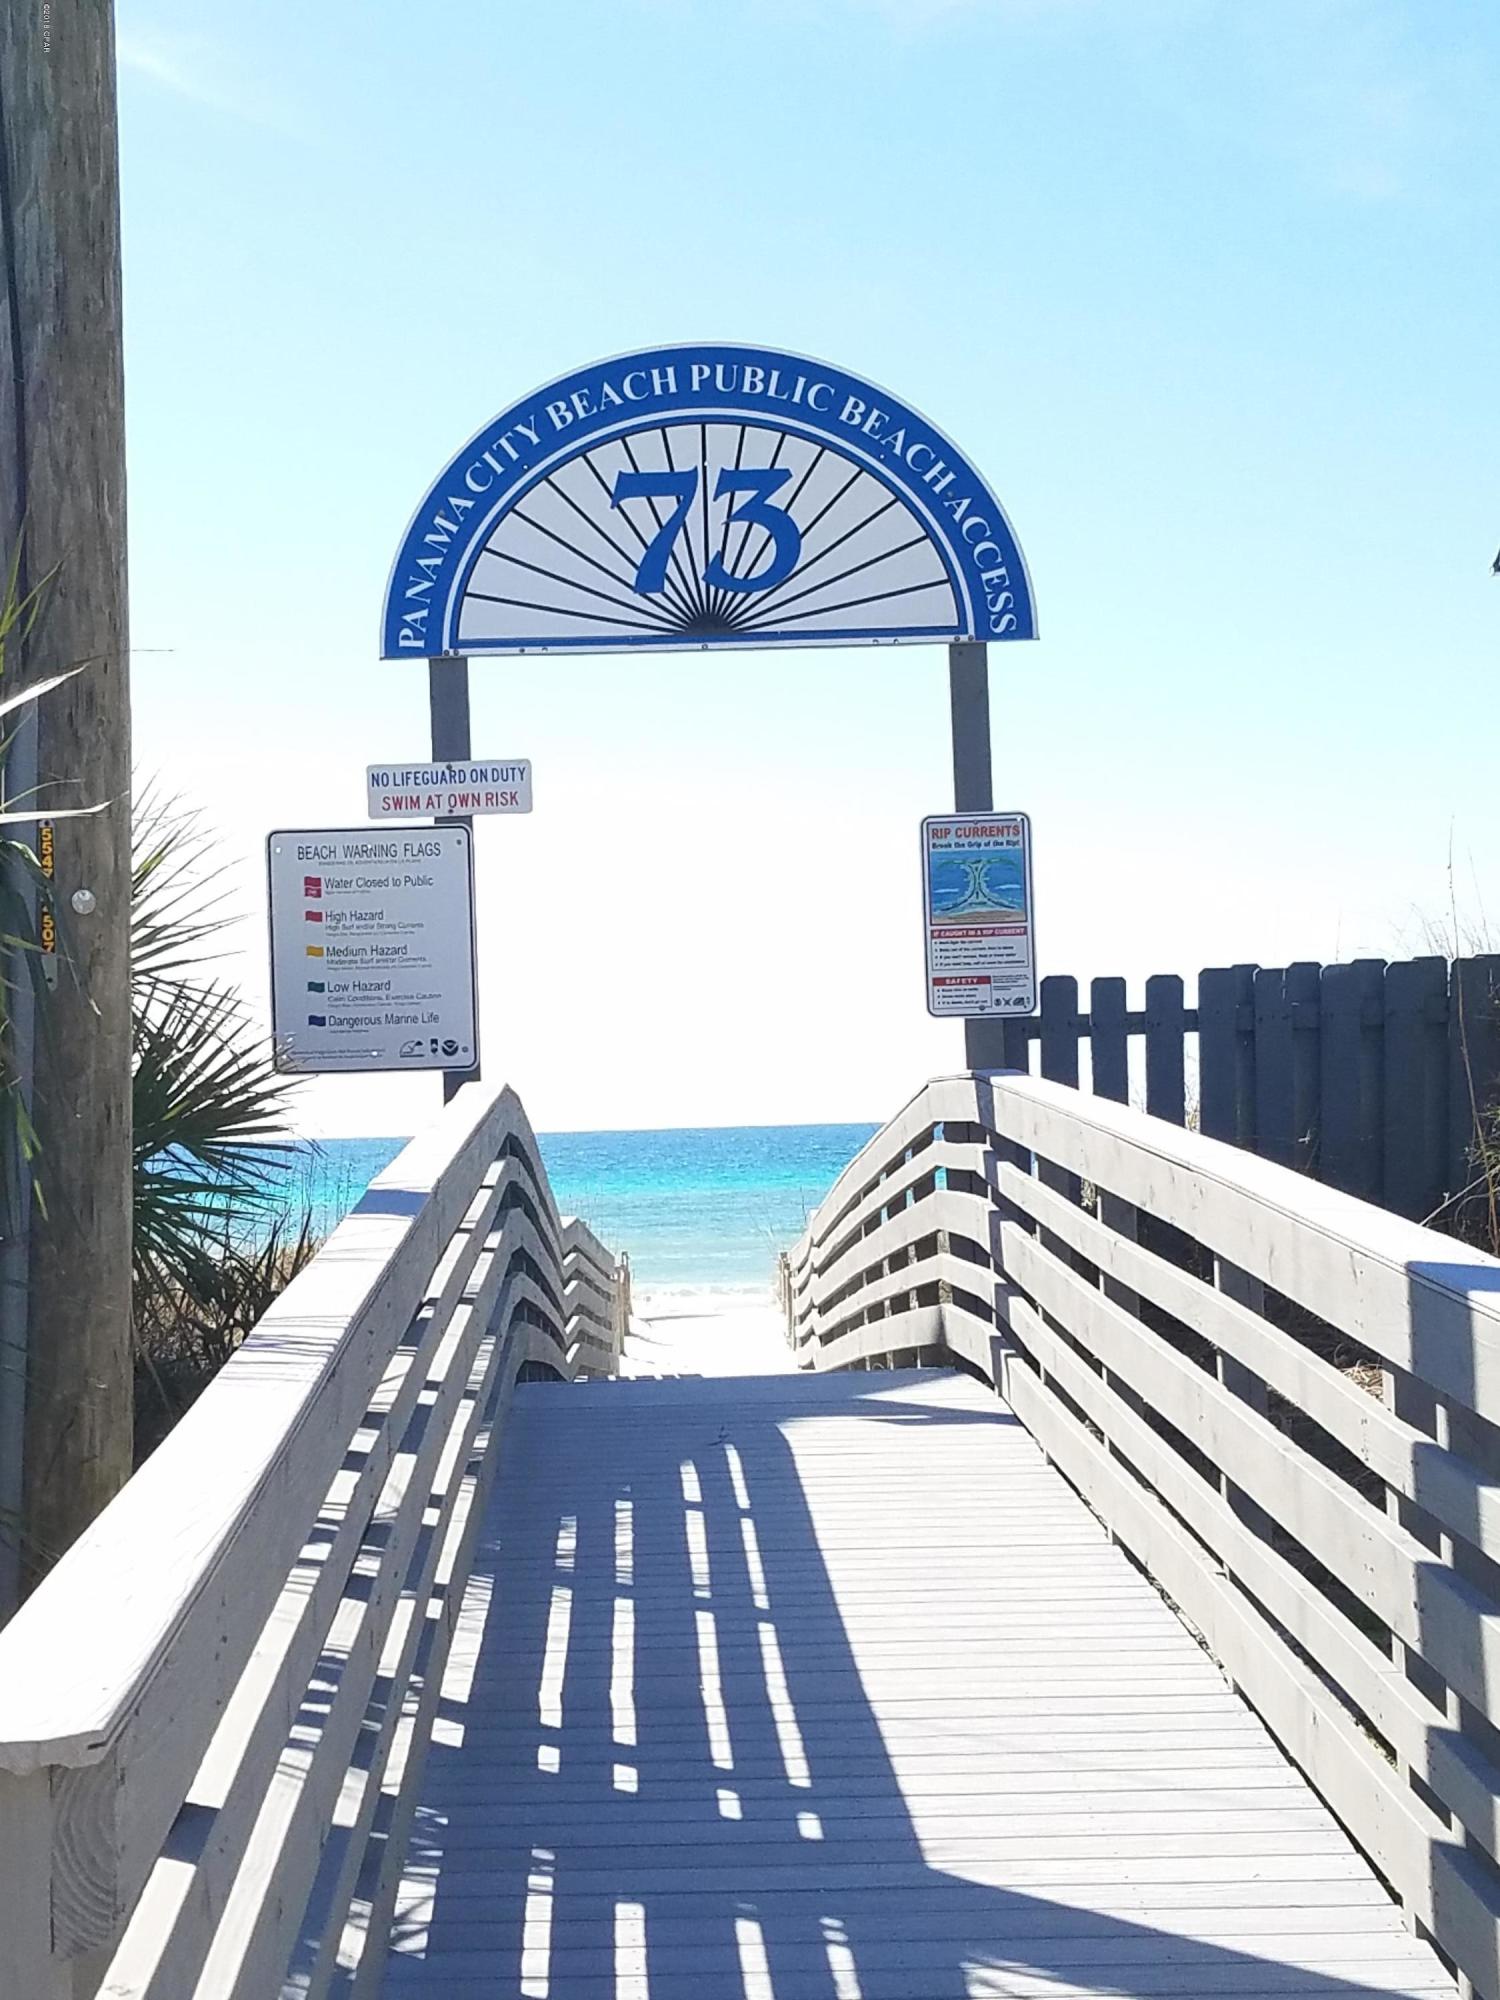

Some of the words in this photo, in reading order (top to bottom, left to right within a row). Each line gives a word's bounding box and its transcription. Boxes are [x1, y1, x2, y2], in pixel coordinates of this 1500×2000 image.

[398, 494, 475, 648] PANAMA
[464, 416, 540, 494] CITY
[546, 366, 678, 431] BEACH
[690, 364, 835, 412] PUBLIC
[838, 395, 957, 495] BEACH
[942, 496, 1017, 634] ACCESS
[609, 464, 802, 594] 73
[371, 772, 390, 787] NO
[393, 768, 466, 786] LIFEGUARD
[470, 768, 488, 783] ON
[492, 767, 526, 782] DUTY
[382, 795, 420, 811] SWIM
[426, 794, 442, 809] AT
[448, 792, 481, 808] OWN
[485, 791, 519, 807] RISK
[932, 828, 951, 839] RIP
[955, 825, 1020, 838] CURRENTS
[298, 845, 337, 860] BEACH
[343, 844, 397, 858] WARNING
[404, 842, 441, 857] FLAGS
[324, 877, 353, 888] Water
[355, 877, 389, 888] Closed
[392, 877, 401, 887] to
[404, 875, 434, 887] Public
[325, 911, 347, 924] High
[350, 910, 384, 921] Hazard
[326, 946, 367, 957] Medium
[370, 945, 408, 956] Hazard
[328, 981, 349, 993] Low
[352, 980, 390, 992] Hazard
[329, 1015, 382, 1028] Dangerous
[385, 1013, 418, 1024] Marine
[422, 1012, 440, 1023] Life
